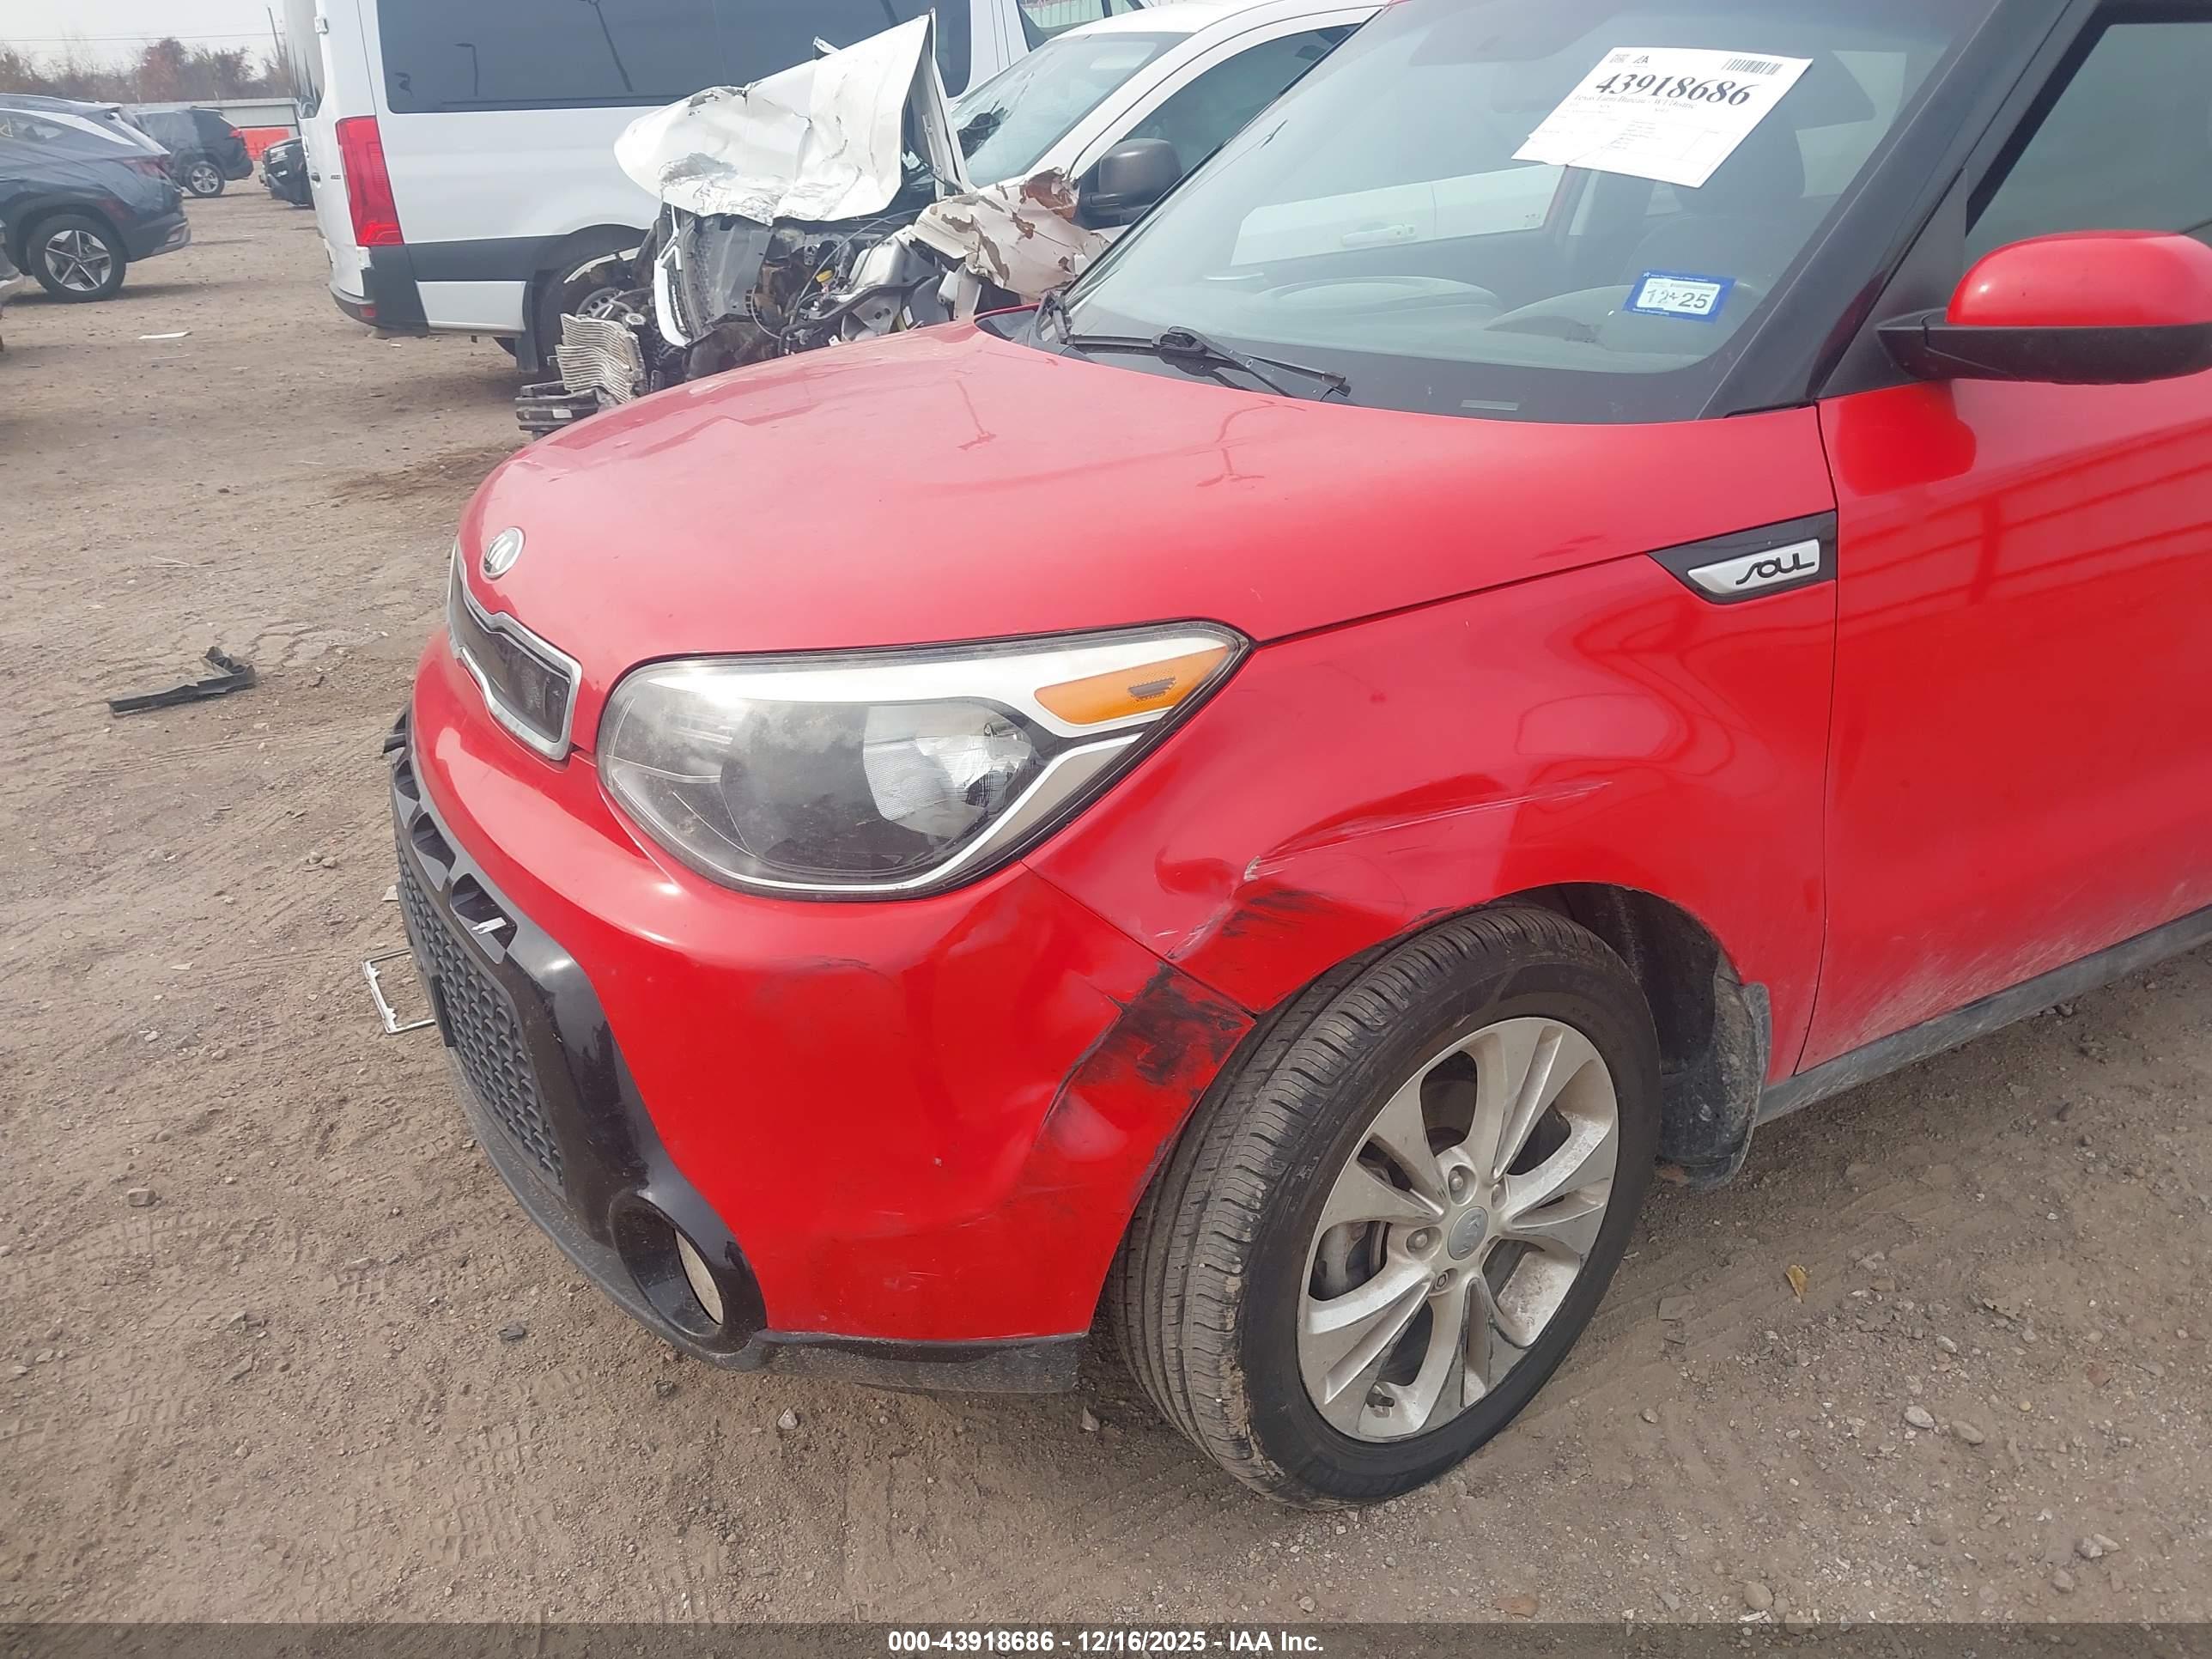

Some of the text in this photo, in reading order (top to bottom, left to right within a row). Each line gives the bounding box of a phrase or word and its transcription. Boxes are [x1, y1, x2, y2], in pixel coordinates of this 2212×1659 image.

[1595, 73, 1759, 106] 43918686
[1677, 292, 1711, 309] 25
[1735, 553, 1815, 585] SOUL
